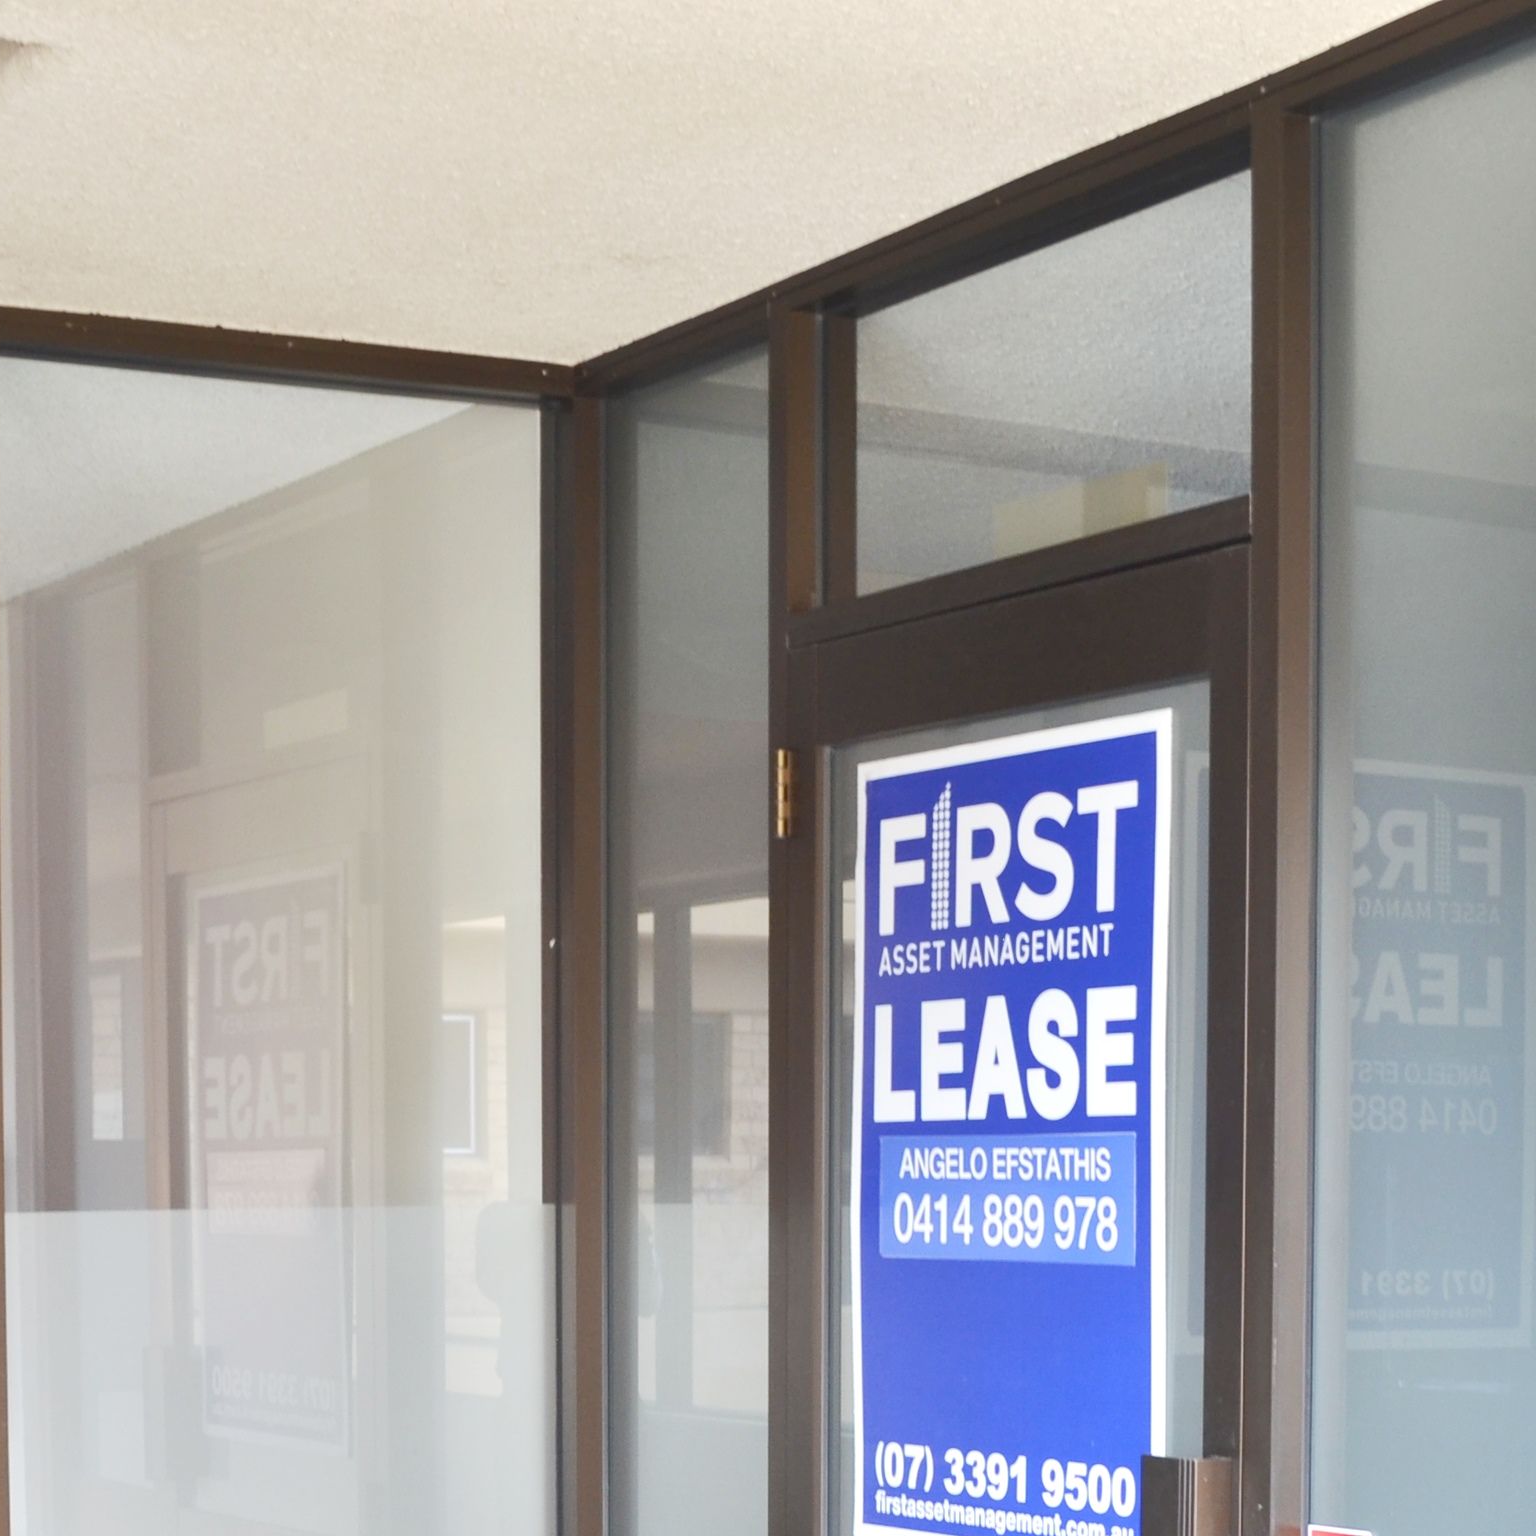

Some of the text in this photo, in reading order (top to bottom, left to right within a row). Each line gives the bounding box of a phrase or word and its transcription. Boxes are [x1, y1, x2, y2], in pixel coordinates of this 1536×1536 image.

[879, 780, 1138, 936] FIRST
[878, 923, 1114, 977] ASSET MANAGEMENT
[873, 984, 1137, 1123] LEASE
[899, 1147, 1111, 1182] ANGELO EFSTATHIS
[893, 1192, 1119, 1252] 0414 889 978
[874, 1441, 1136, 1517] (07) 3391 9500
